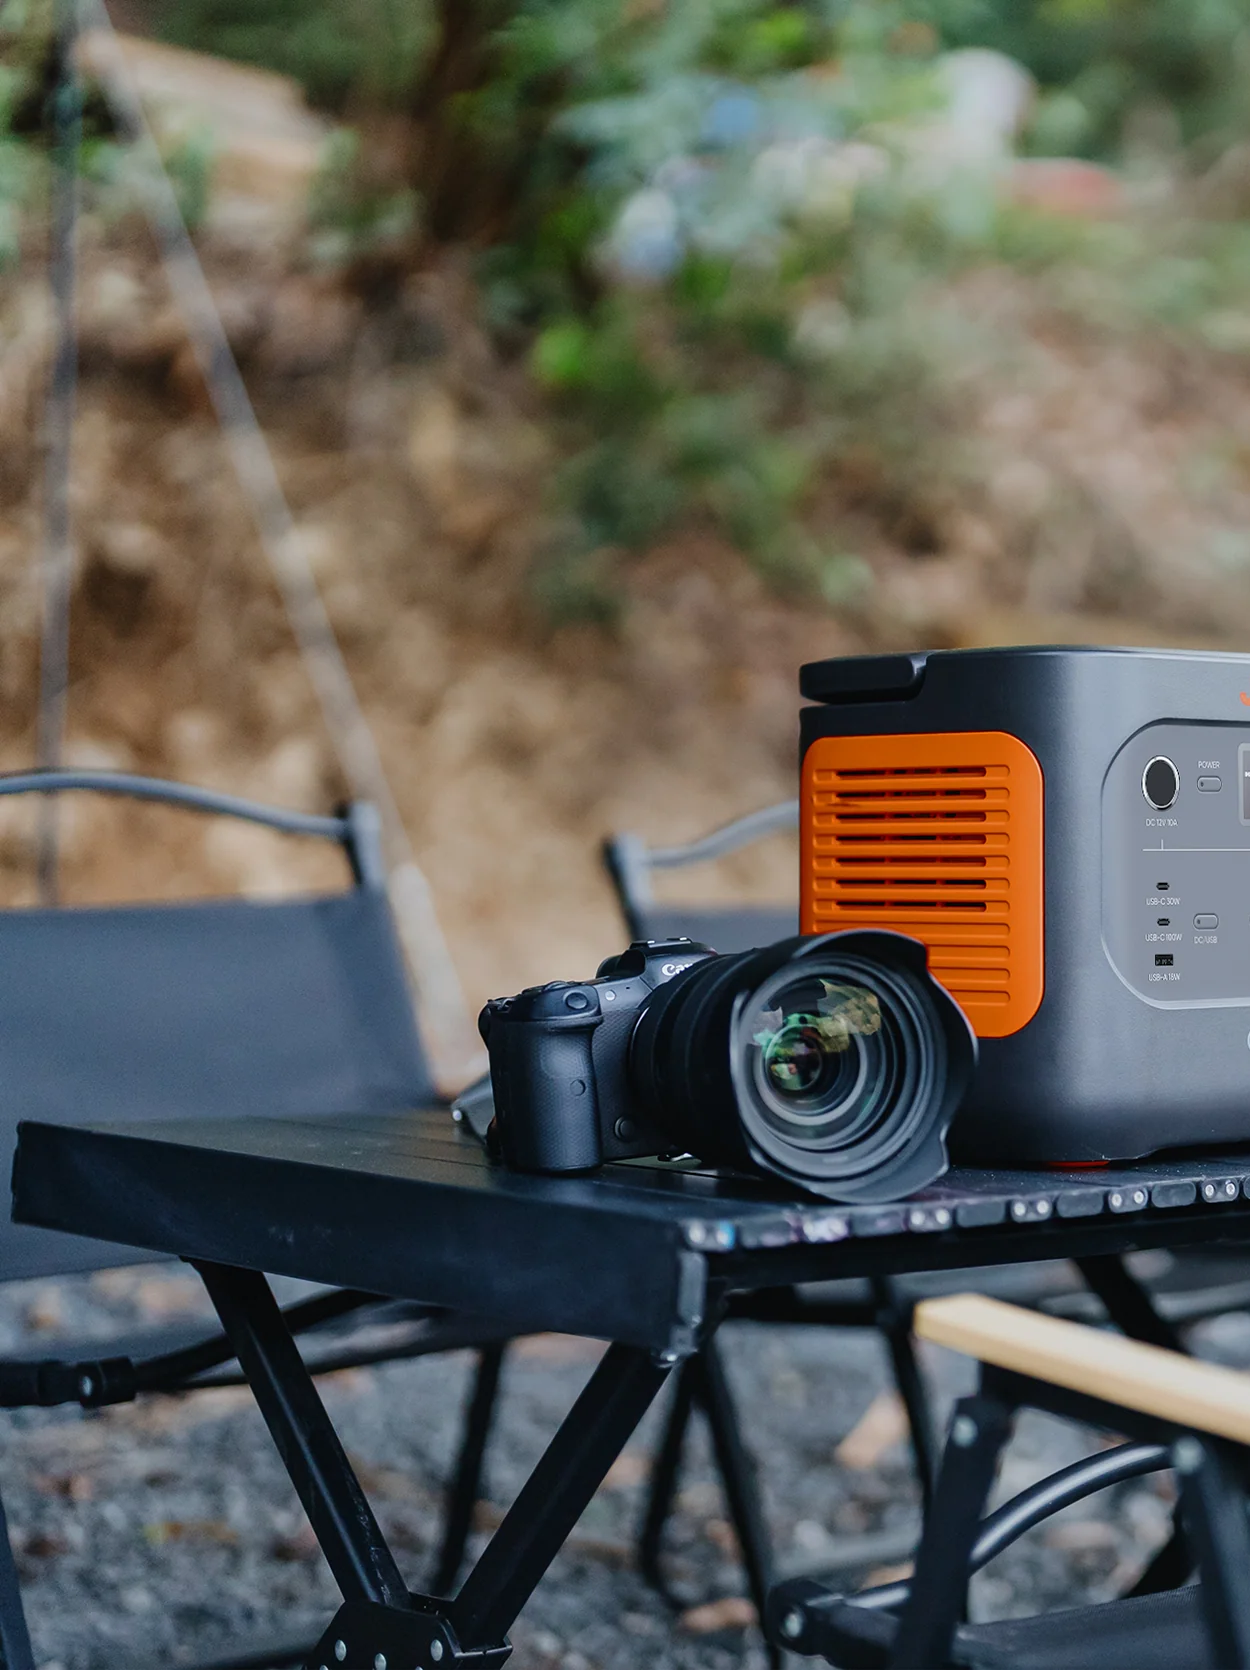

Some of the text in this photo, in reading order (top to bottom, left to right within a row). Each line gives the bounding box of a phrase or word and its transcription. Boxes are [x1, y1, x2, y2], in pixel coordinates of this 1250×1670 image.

[1198, 760, 1221, 769] POWER
[1145, 818, 1156, 827] DC
[1156, 818, 1168, 827] 12V
[1146, 897, 1166, 906] USB-C
[1145, 933, 1183, 942] USB-C 100W
[1194, 936, 1218, 944] DC/USB
[1148, 973, 1168, 982] USB-A
